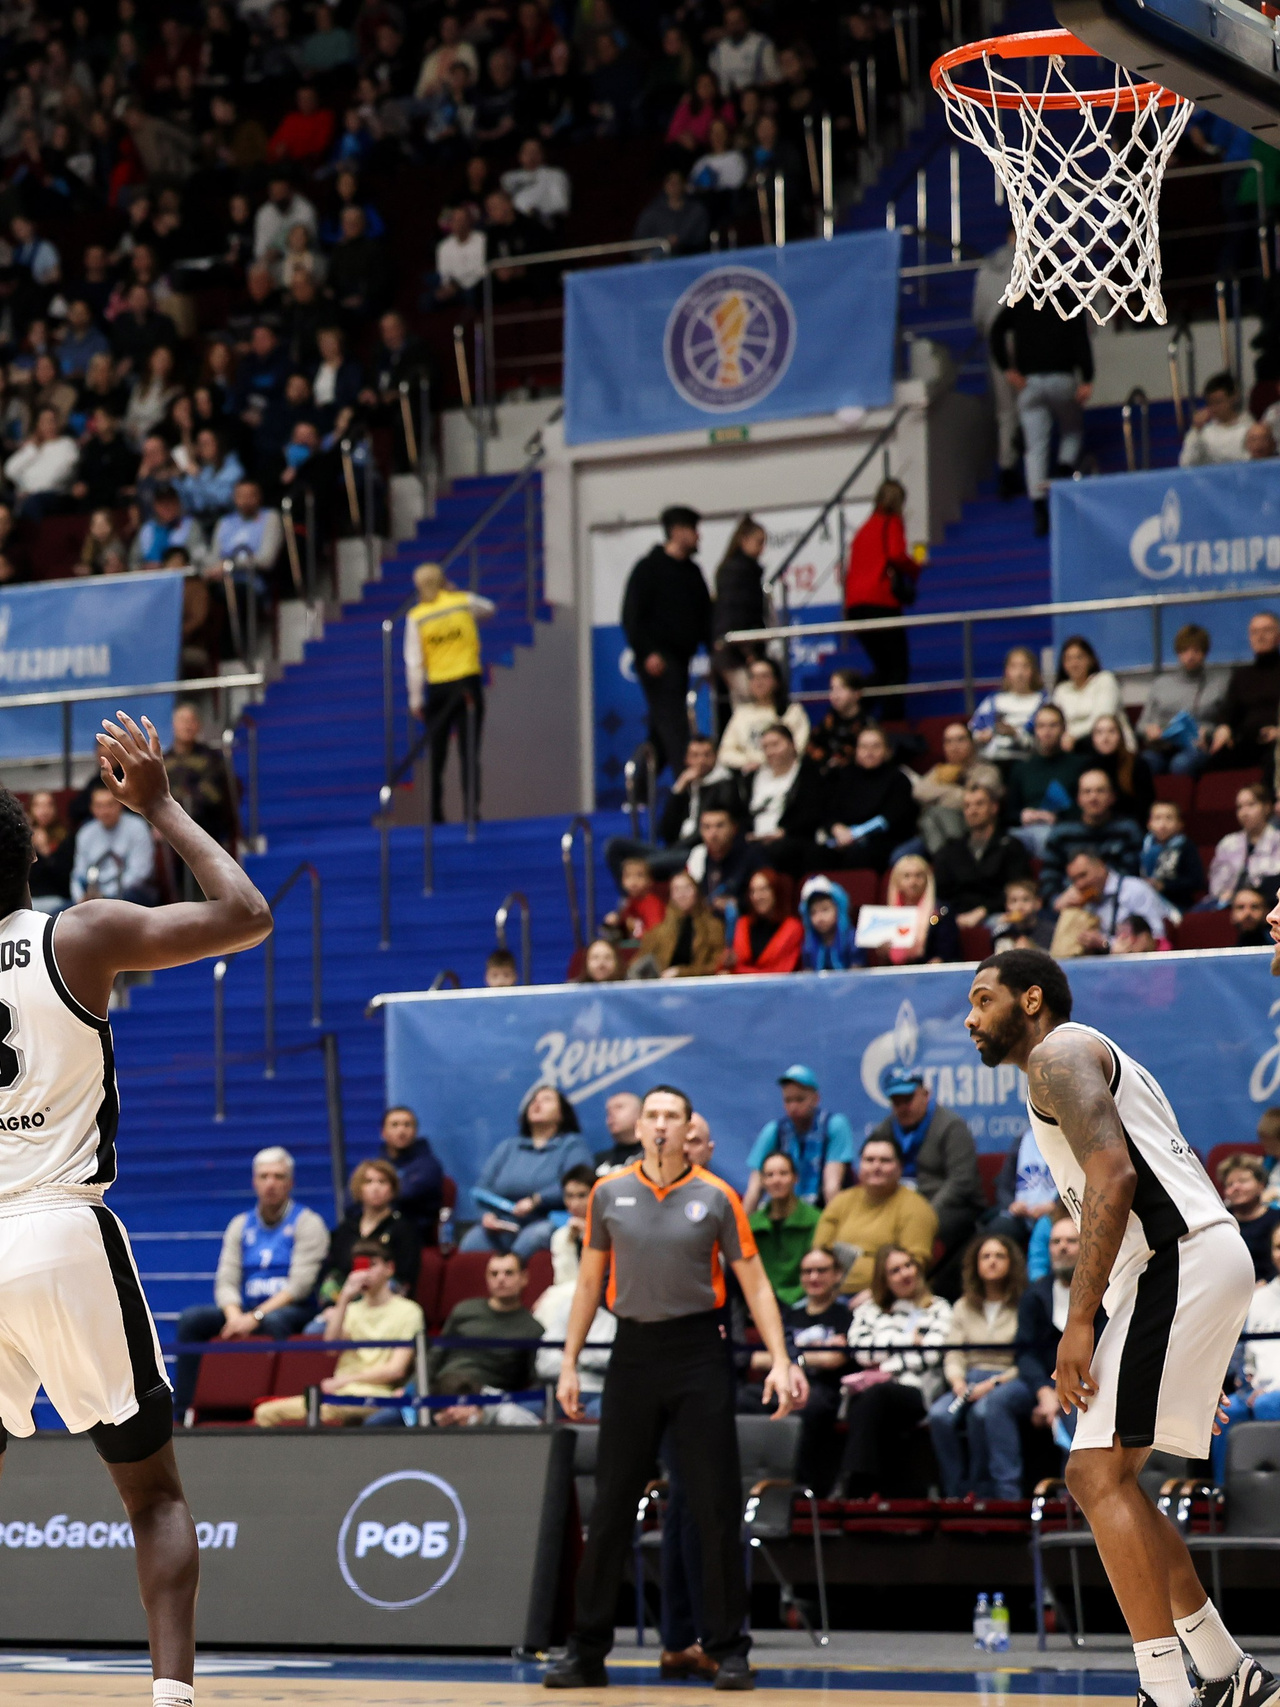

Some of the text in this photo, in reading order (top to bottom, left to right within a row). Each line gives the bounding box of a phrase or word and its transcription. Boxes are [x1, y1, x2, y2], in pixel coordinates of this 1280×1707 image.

[1184, 534, 1280, 577] ГАЗПРО
[923, 1064, 1028, 1107] ГАЗПР
[354, 1520, 451, 1559] РФБ
